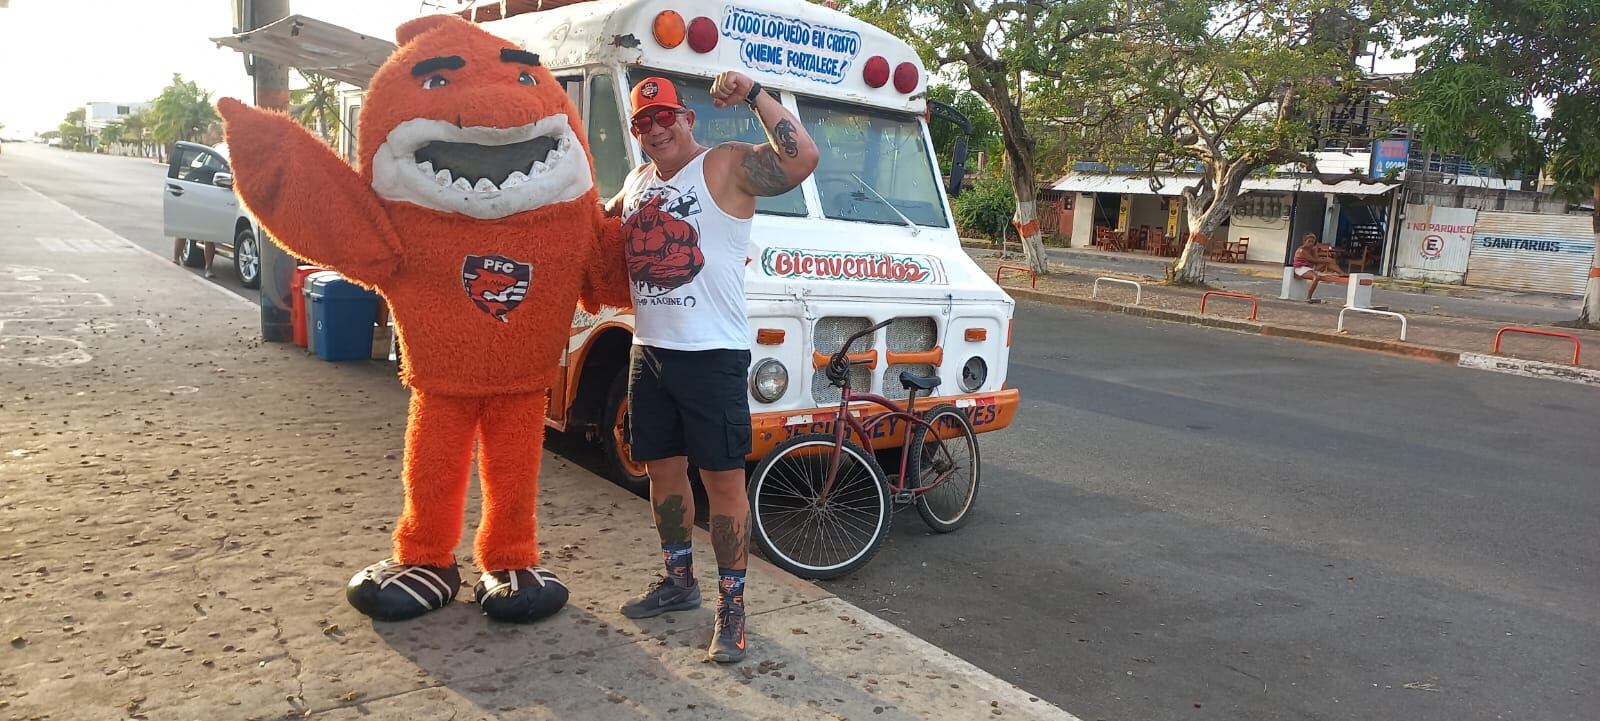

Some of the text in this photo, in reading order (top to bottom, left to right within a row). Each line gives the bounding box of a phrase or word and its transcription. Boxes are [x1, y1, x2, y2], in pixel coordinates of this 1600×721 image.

[811, 30, 826, 49] EN
[826, 33, 857, 56] CRISTO
[1483, 236, 1560, 252] SANITARIOS
[483, 258, 515, 274] PFC
[774, 251, 930, 282] Bienvenidos
